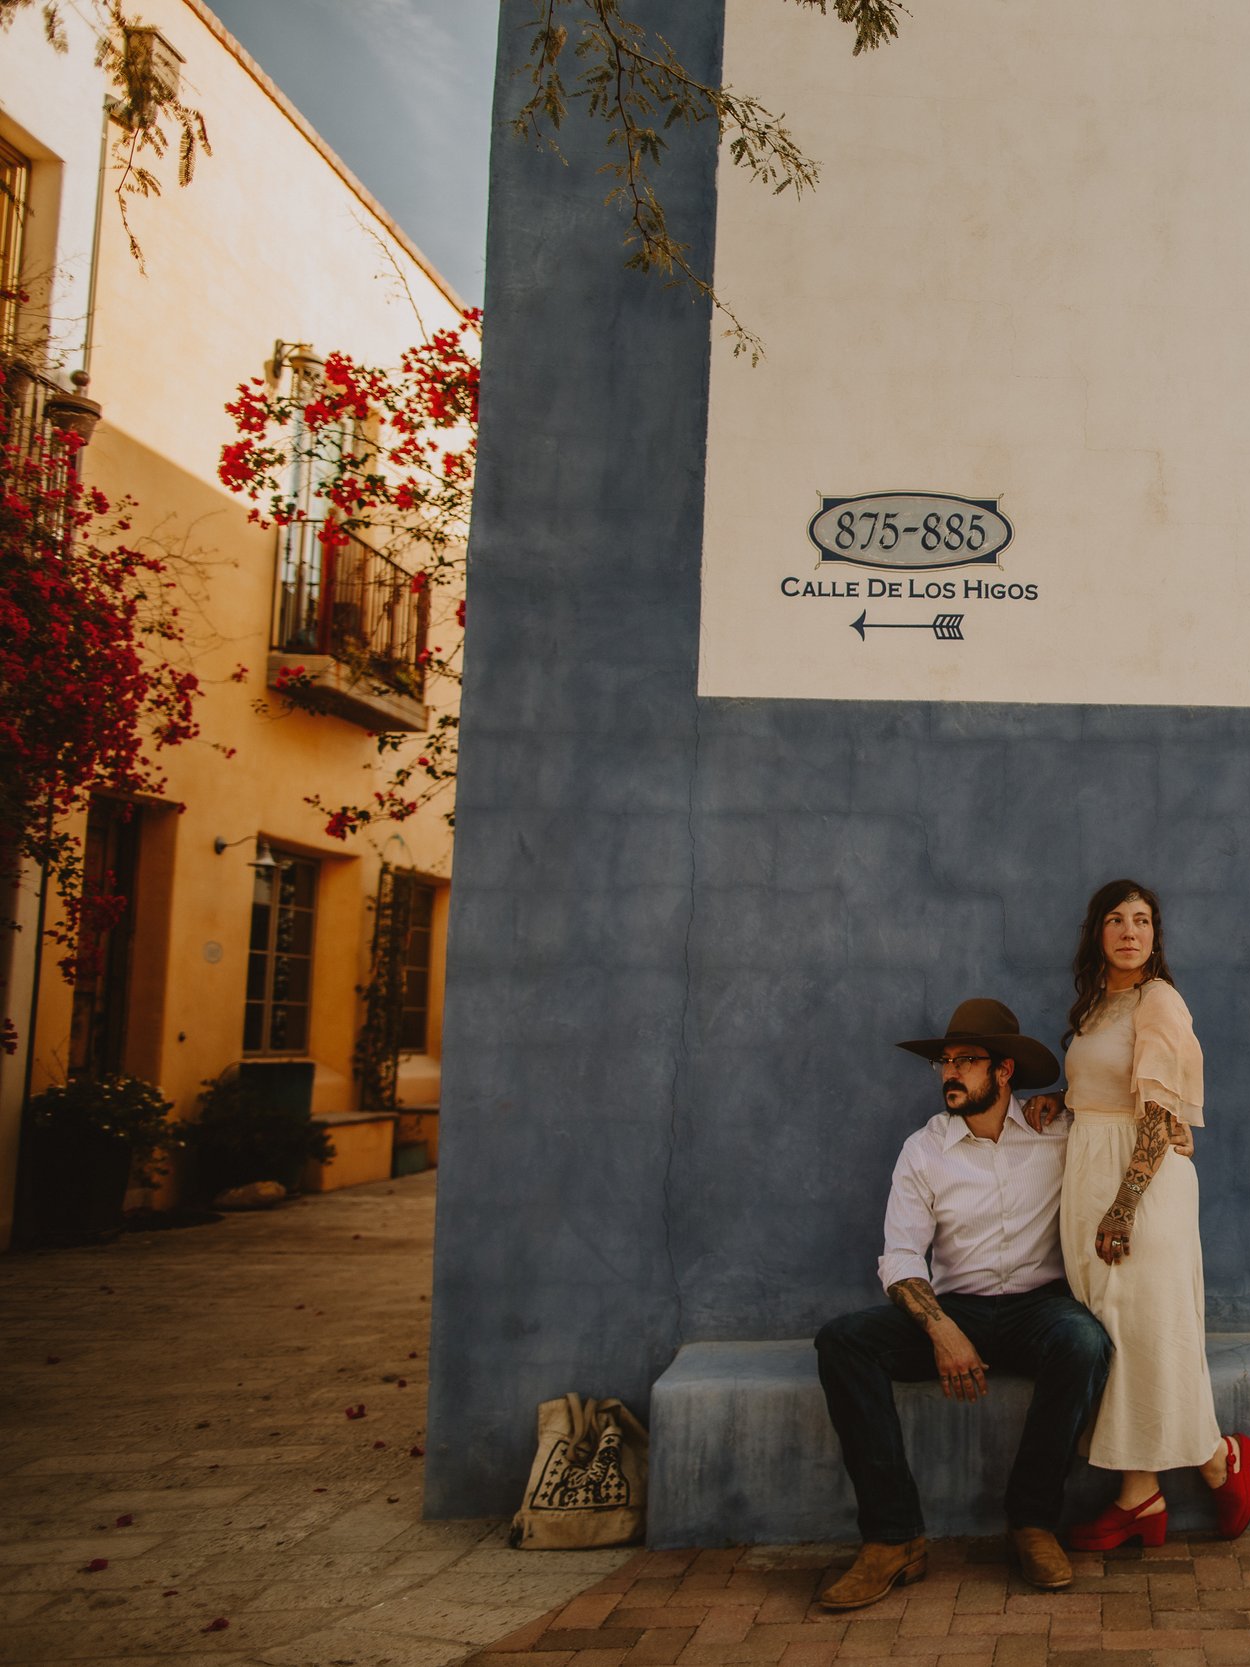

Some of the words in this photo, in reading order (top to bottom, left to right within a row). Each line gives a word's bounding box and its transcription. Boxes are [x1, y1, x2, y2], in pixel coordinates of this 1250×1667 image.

[834, 511, 986, 551] 875-885
[781, 577, 860, 598] CALLE
[867, 579, 903, 598] DE
[908, 579, 956, 599] LOS
[963, 579, 1039, 601] HIGOS
